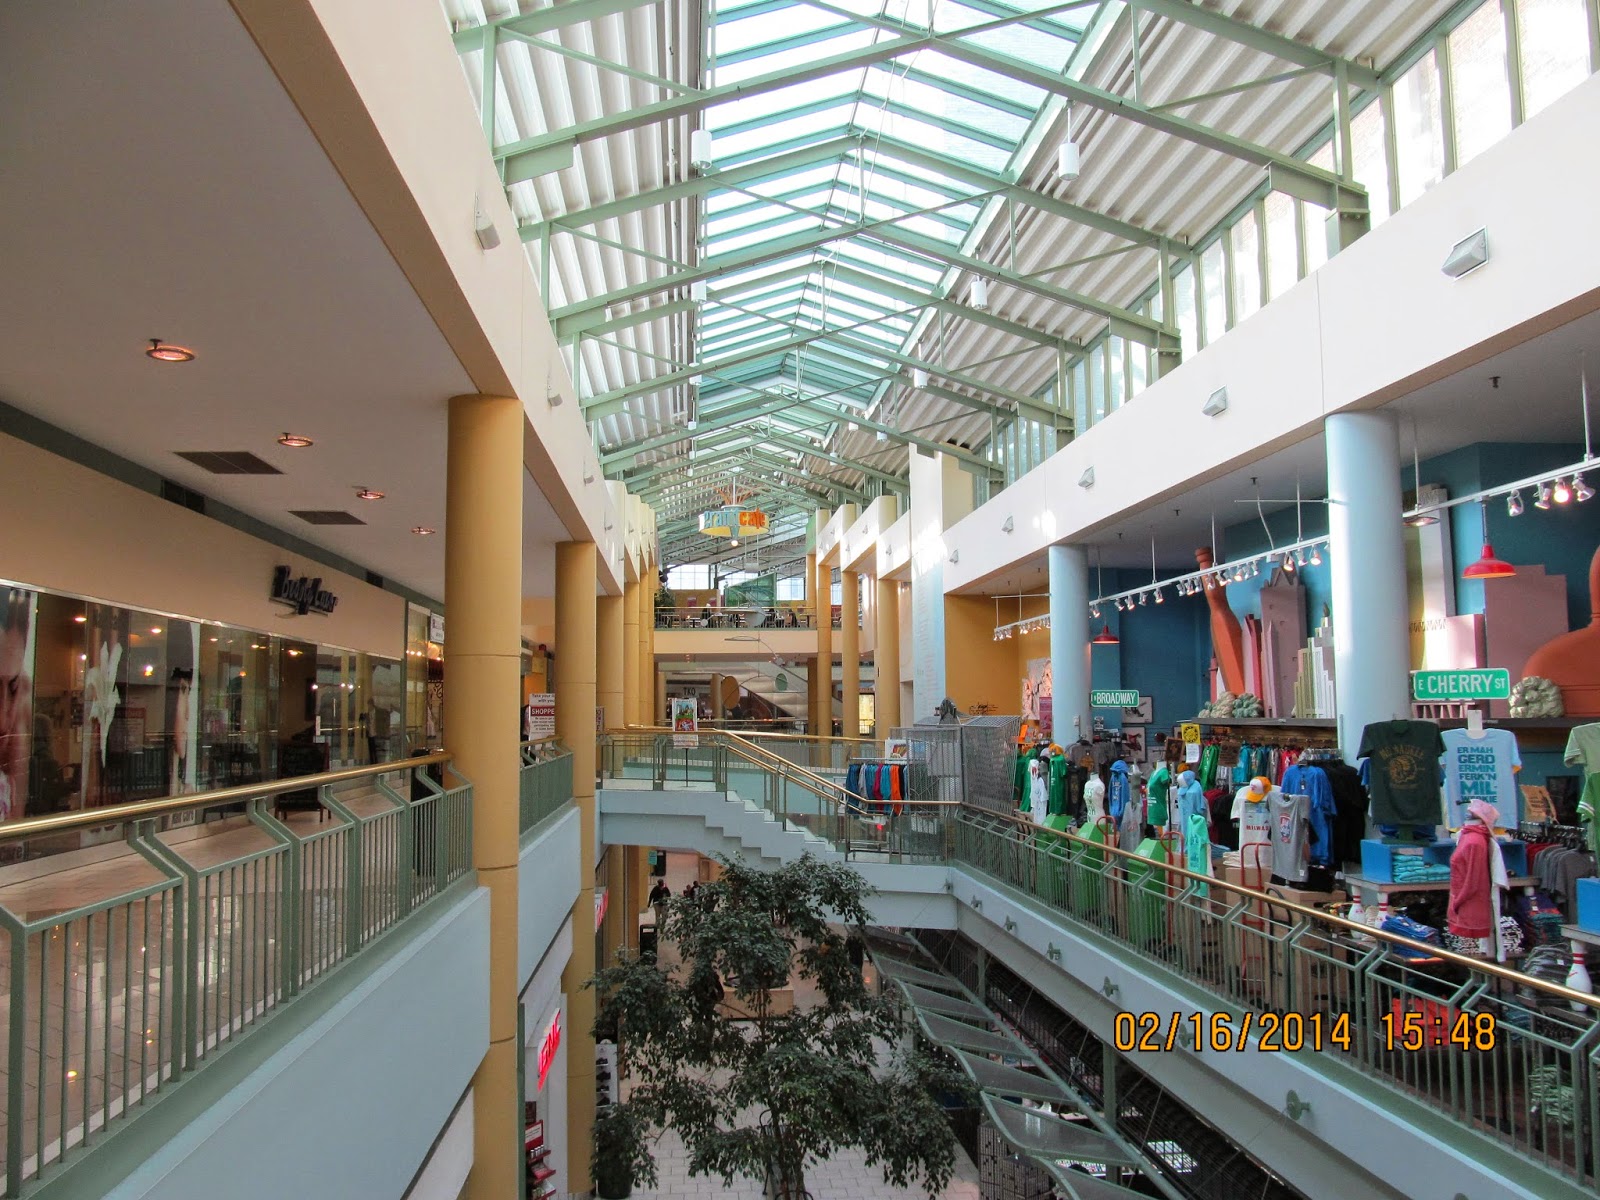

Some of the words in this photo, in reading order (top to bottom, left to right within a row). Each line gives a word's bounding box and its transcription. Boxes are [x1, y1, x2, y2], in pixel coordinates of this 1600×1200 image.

[1418, 679, 1425, 690] E
[1427, 674, 1494, 694] CHERRY
[1494, 678, 1506, 689] ST
[1096, 692, 1136, 704] BROADWAY
[1458, 754, 1496, 764] GERD
[1458, 764, 1496, 772] ERMIN
